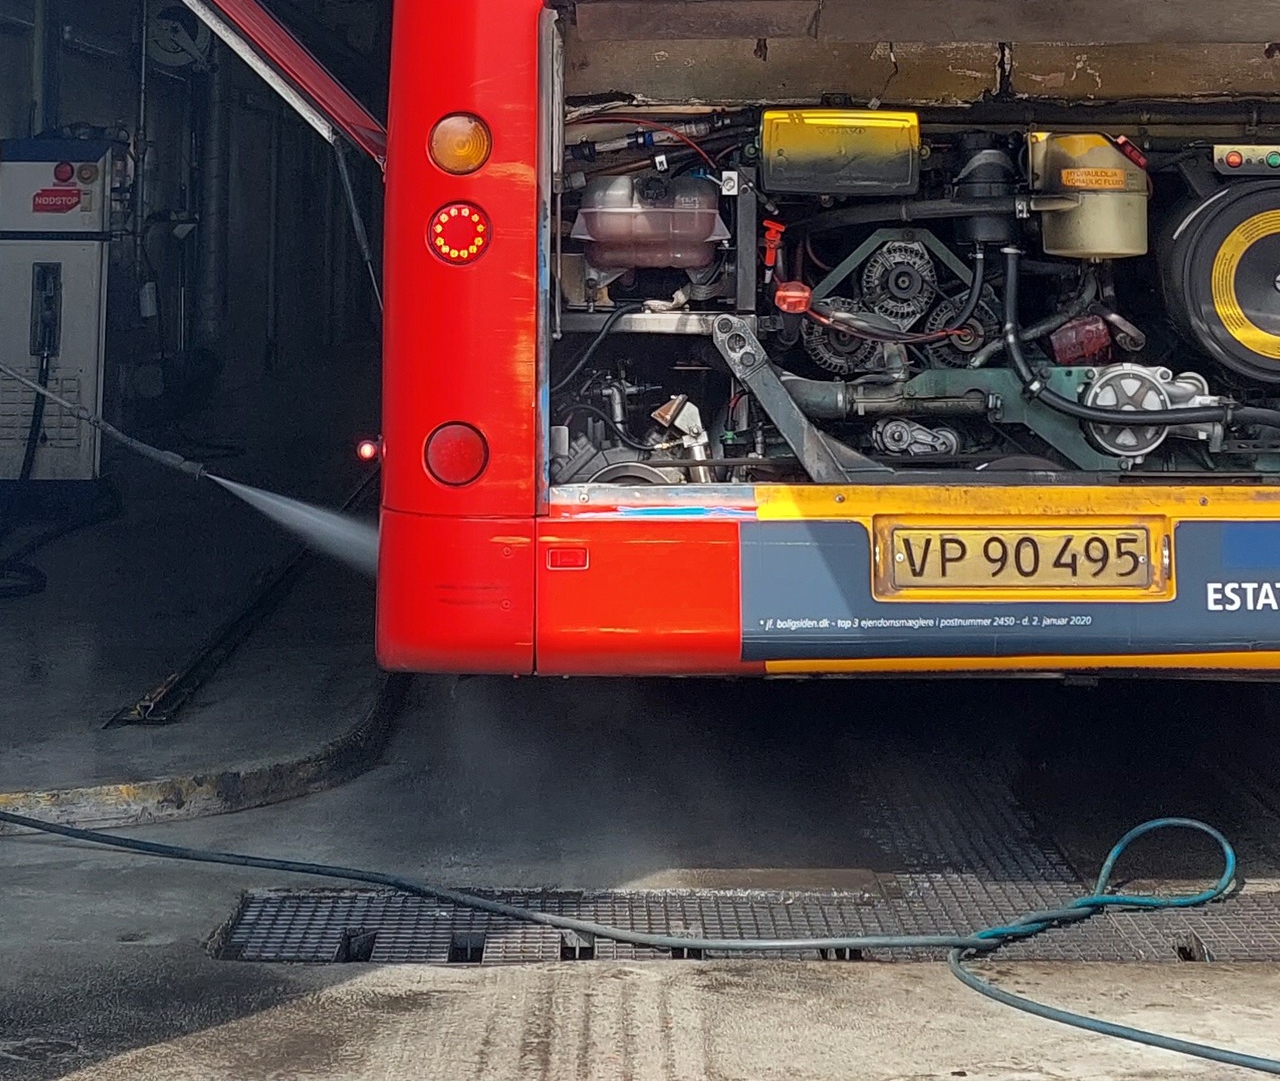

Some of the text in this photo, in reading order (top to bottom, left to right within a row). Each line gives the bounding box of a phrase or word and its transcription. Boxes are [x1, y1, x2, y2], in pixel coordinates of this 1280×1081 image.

[903, 536, 1140, 578] VP 90 495
[776, 618, 830, 631] boligsiden.dk
[837, 619, 851, 630] top
[852, 618, 859, 628] 3
[860, 617, 934, 630] ejendomsmæglere
[940, 617, 992, 628] postnummer
[993, 617, 1015, 626] 2450
[1022, 617, 1030, 626] d.
[1032, 616, 1040, 626] 2.
[1041, 616, 1068, 628] januar
[1070, 616, 1092, 626] 2020
